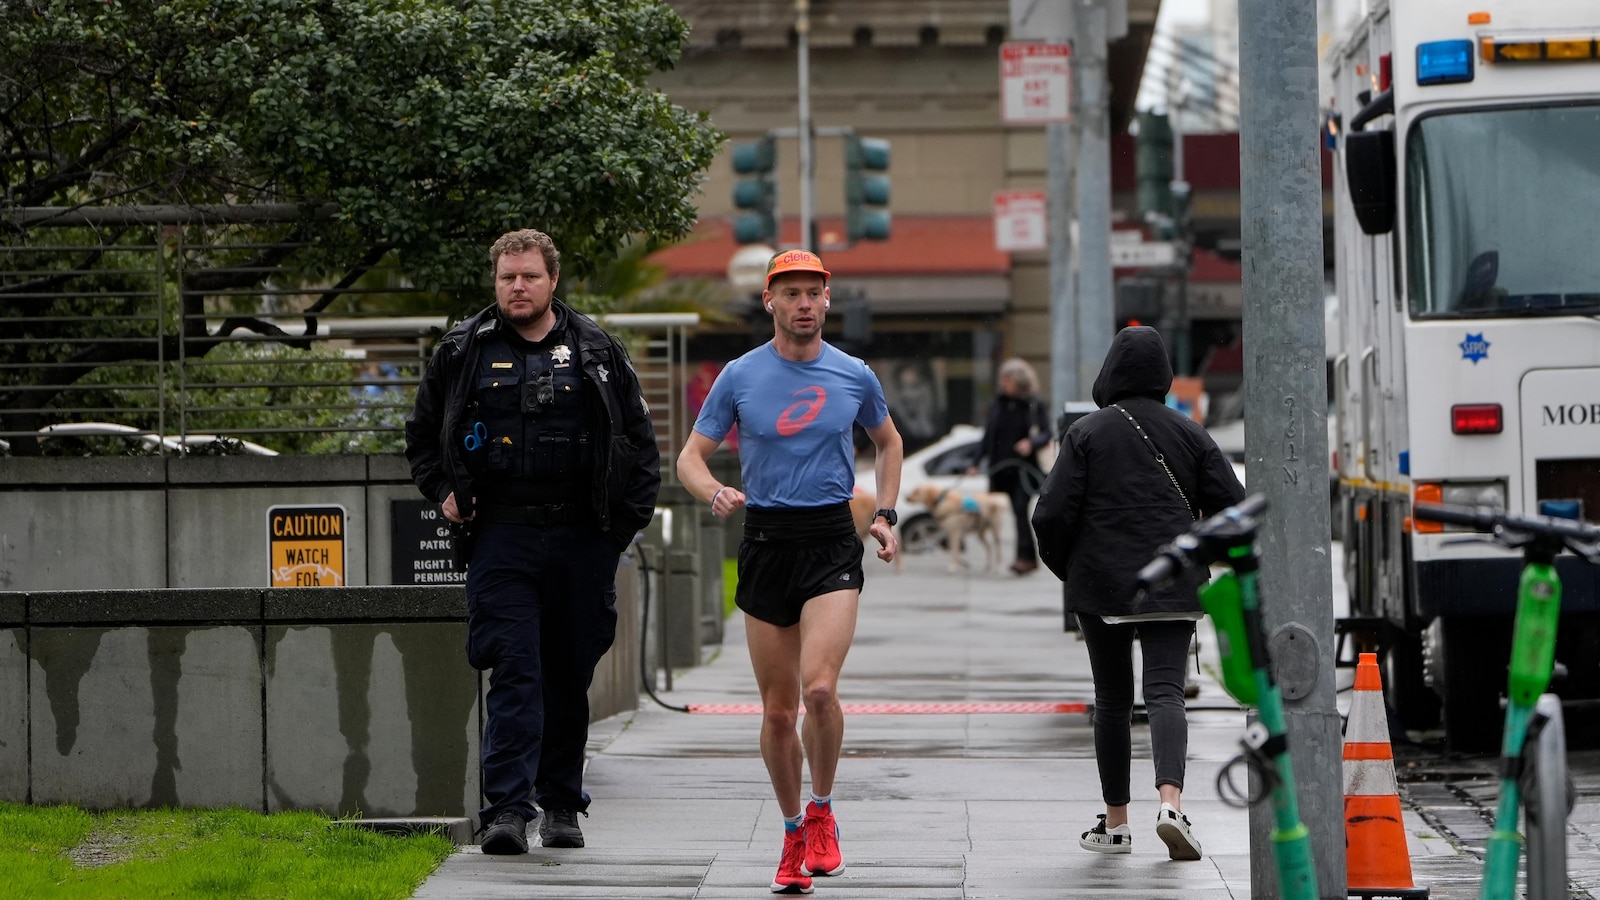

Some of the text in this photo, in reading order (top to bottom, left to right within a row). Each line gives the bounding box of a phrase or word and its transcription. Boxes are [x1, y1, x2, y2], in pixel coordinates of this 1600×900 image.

[783, 252, 810, 264] ciele
[1463, 341, 1486, 354] SFPD
[420, 510, 437, 520] NO
[273, 514, 340, 536] CAUTION
[285, 548, 329, 565] WATCH
[413, 560, 445, 570] RIGHT
[296, 572, 321, 587] FOR
